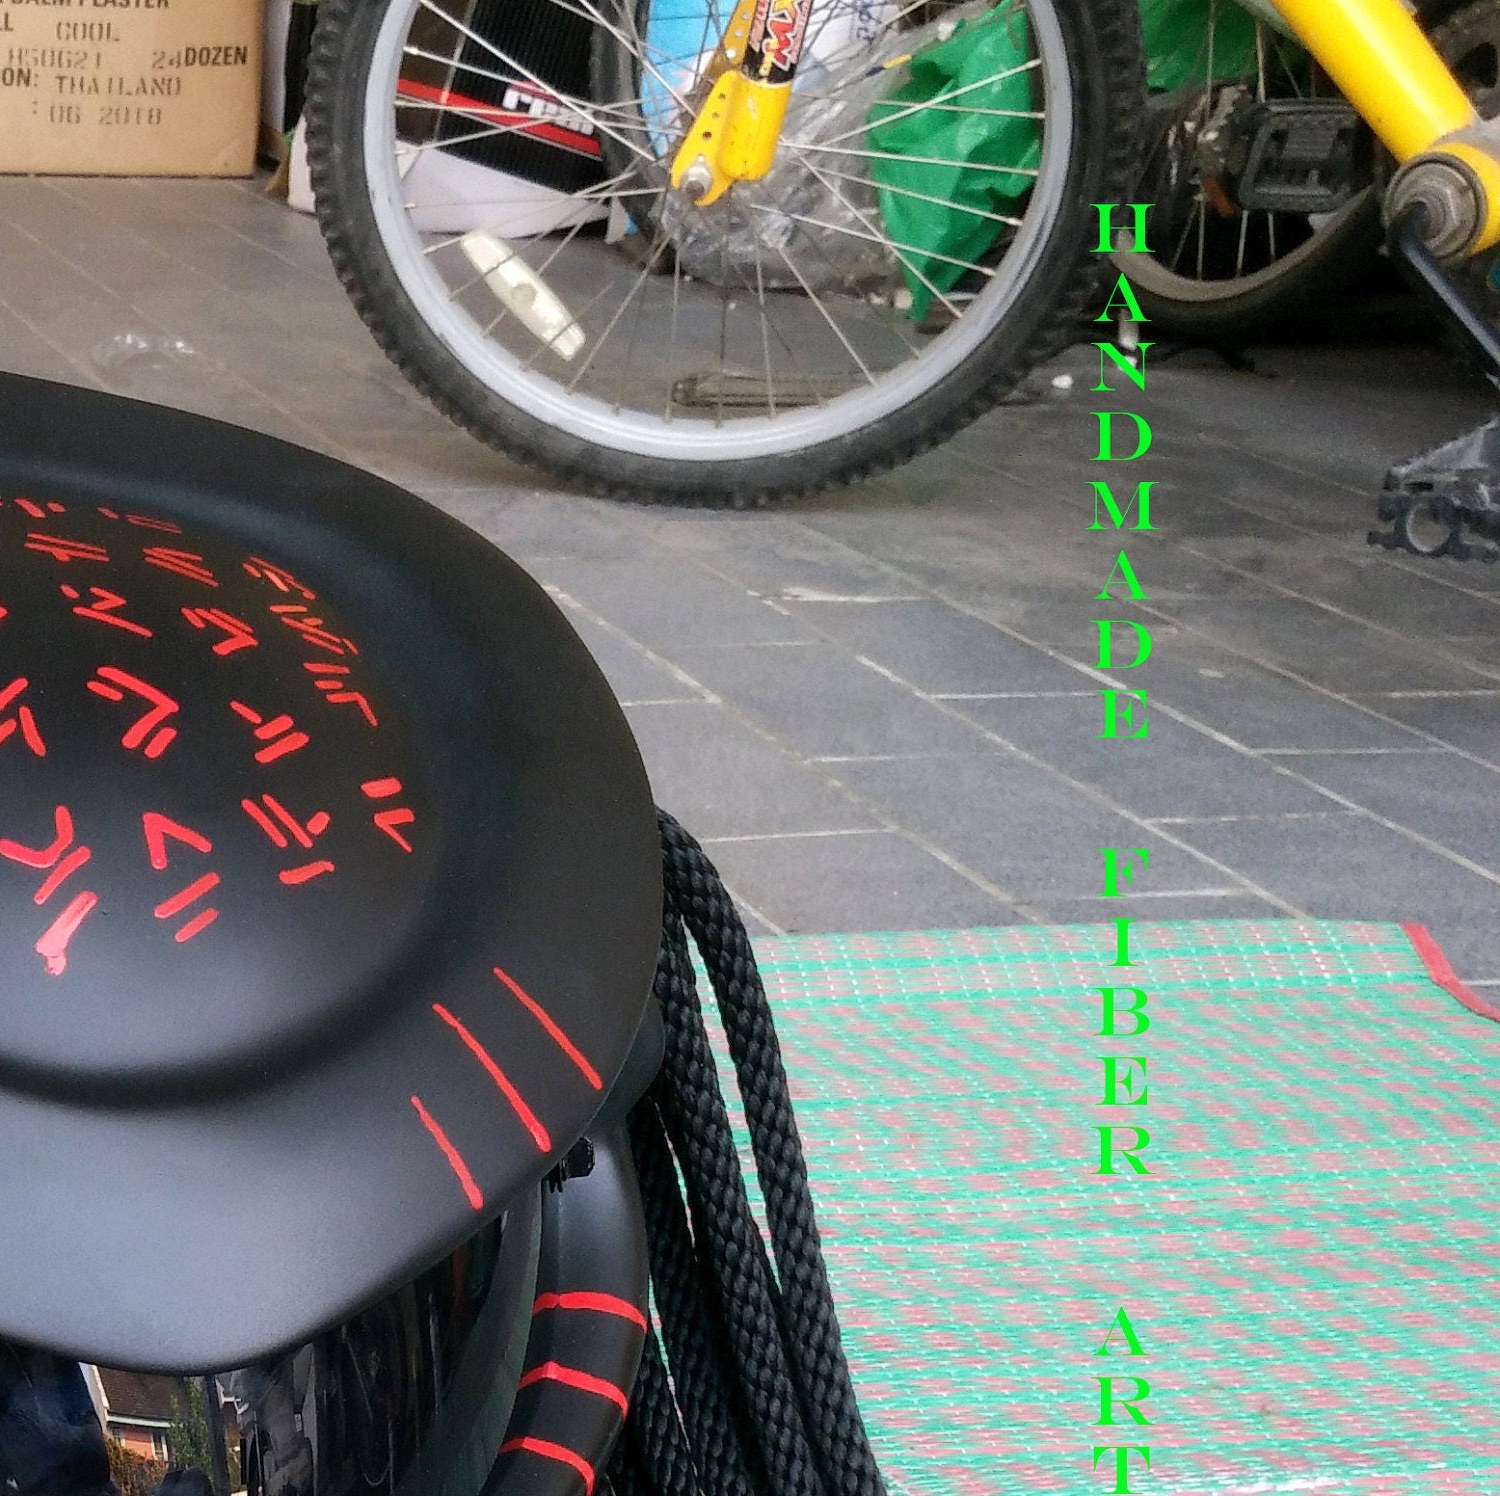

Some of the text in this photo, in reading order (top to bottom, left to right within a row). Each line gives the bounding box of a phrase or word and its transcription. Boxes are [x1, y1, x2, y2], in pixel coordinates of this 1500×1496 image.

[56, 22, 120, 42] COOL
[184, 45, 248, 67] DOZEN
[53, 75, 182, 97] THAILAND
